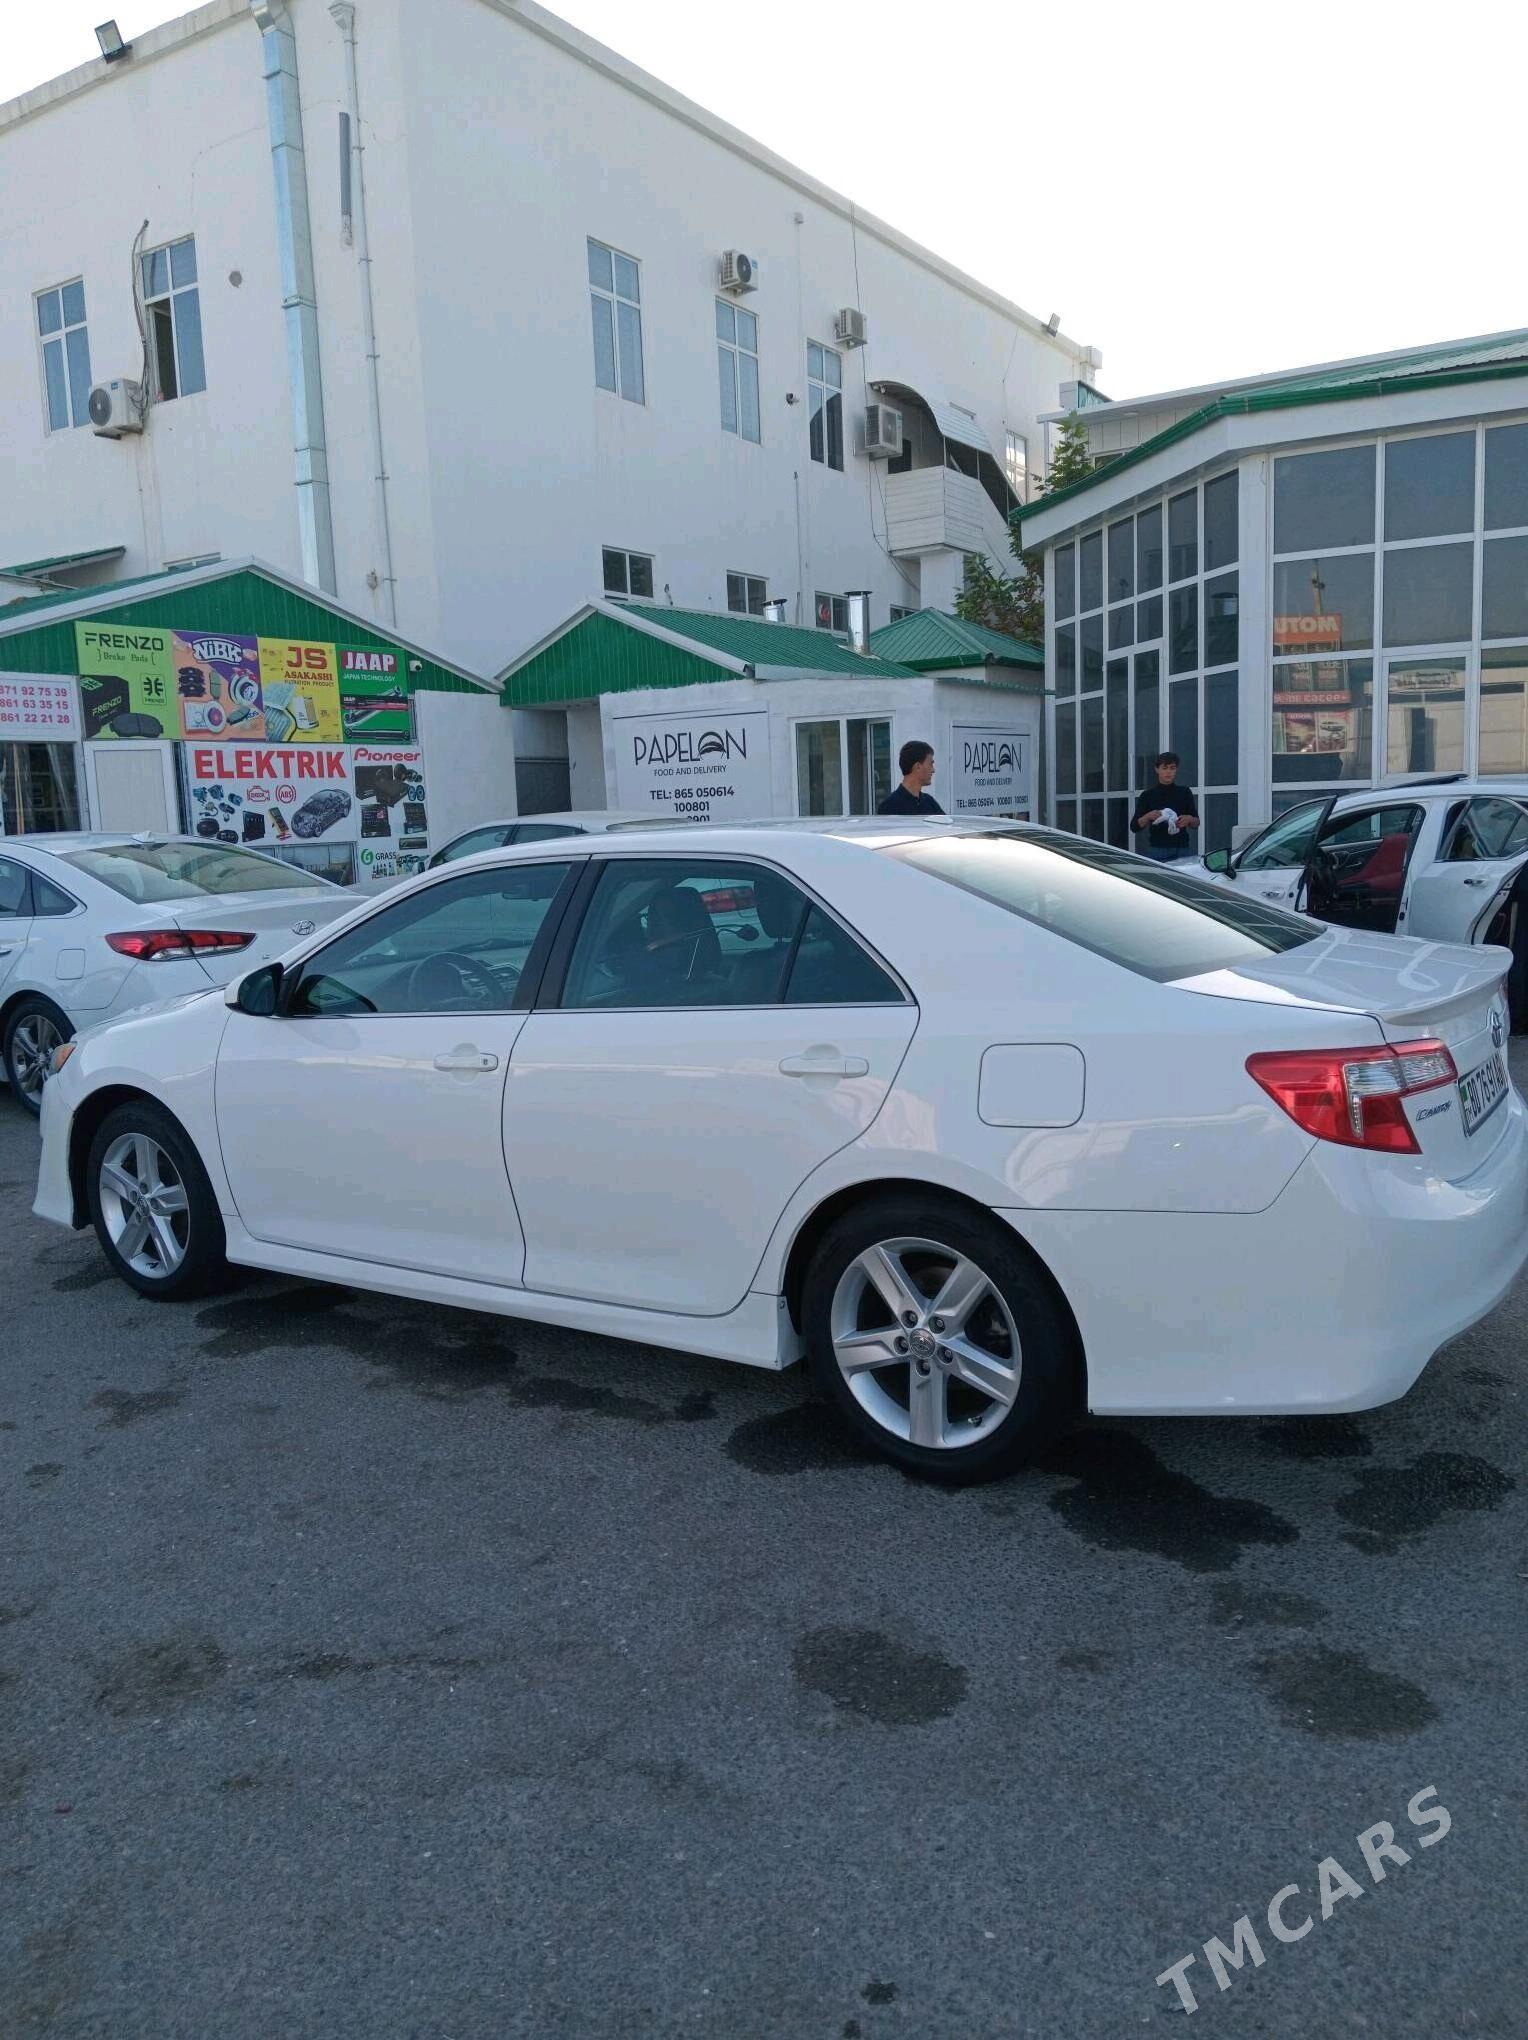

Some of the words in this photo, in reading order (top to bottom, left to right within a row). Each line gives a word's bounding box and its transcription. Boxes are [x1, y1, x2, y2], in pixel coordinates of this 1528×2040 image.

[85, 632, 164, 651] FRENZO
[286, 646, 328, 670] JS
[345, 651, 394, 671] JAAP
[284, 671, 333, 680] ASAKASHI
[361, 674, 395, 682] TECHNOLOGY
[21, 686, 35, 696] 92
[38, 687, 51, 697] 75
[54, 688, 68, 697] 39
[0, 699, 18, 708] 861
[23, 699, 36, 709] 63
[39, 700, 52, 710] 35
[56, 700, 69, 710] 15
[0, 712, 20, 722] 861
[24, 713, 38, 723] 22
[40, 714, 53, 723] 21
[57, 714, 70, 724] 28
[634, 728, 747, 766] PAPELON
[354, 747, 421, 761] Pioneer
[964, 742, 1022, 773] PAPELON
[194, 750, 347, 779] ELEKTRIK
[653, 768, 674, 777] FOOD
[676, 767, 692, 776] AND
[694, 765, 727, 775] DELIVERY
[650, 789, 672, 800] TEL:
[674, 788, 693, 799] 865
[696, 786, 735, 798] 050614
[674, 801, 710, 812] 100801
[957, 799, 967, 808] TEL:
[375, 851, 397, 860] GRASS
